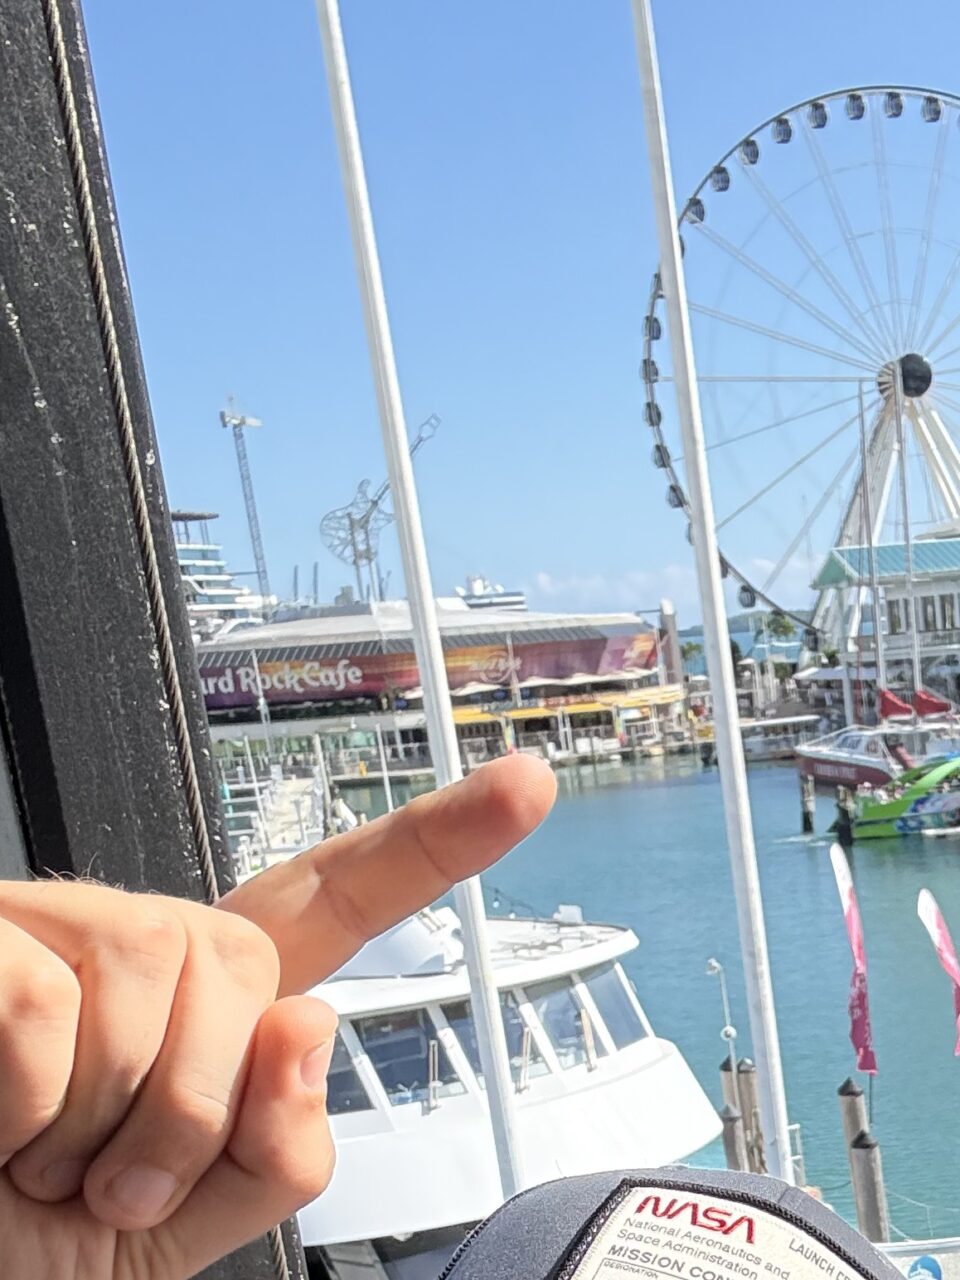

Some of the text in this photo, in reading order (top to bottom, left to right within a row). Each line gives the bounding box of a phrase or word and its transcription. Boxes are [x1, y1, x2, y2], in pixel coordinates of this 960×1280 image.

[201, 659, 363, 696] ard Rock Cafe
[635, 1195, 755, 1244] NASA
[607, 1244, 685, 1273] MISSION
[617, 1229, 758, 1280] Space Administration
[624, 1218, 790, 1280] National Aeronautics and
[789, 1238, 835, 1276] LAUNCH
